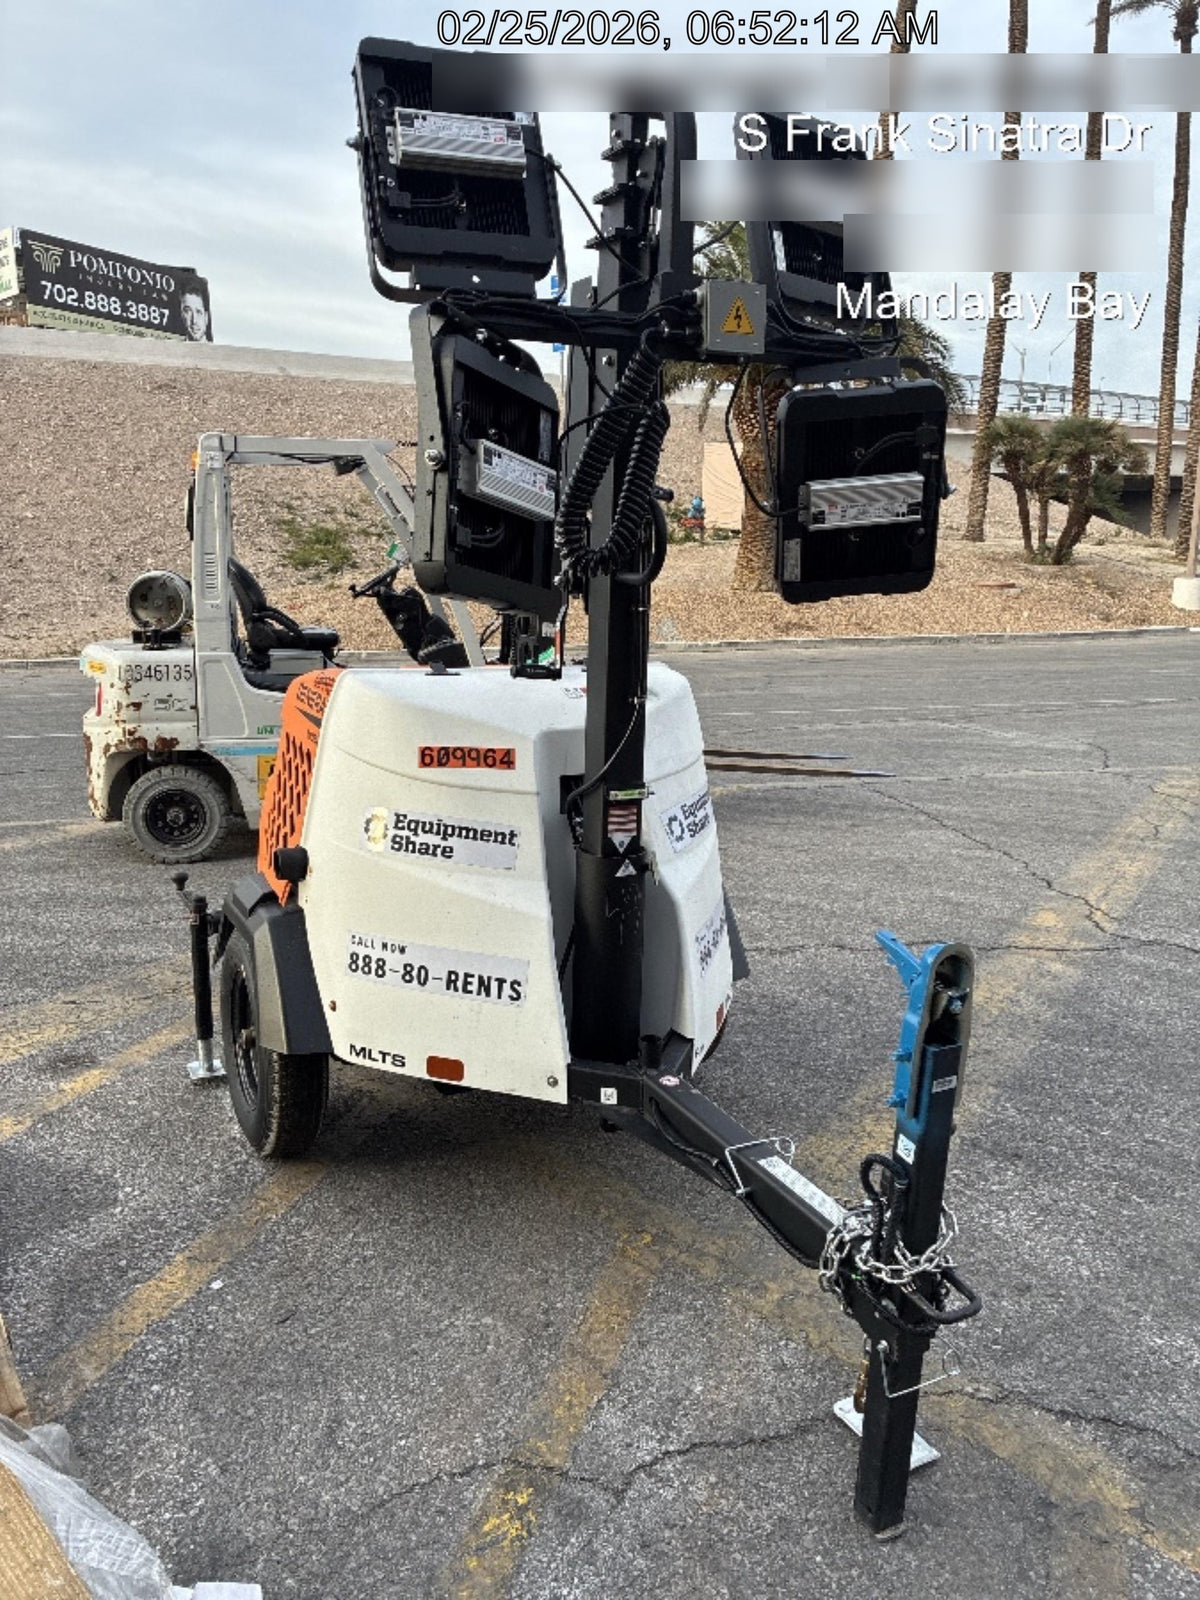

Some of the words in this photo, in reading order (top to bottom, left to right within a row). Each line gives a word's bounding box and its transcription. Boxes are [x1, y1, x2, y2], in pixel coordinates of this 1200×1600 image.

[69, 250, 175, 292] POMPONIO
[40, 281, 170, 326] 702.888.3887
[420, 746, 515, 767] 609964
[393, 812, 518, 848] Equipment
[390, 834, 454, 859] Share
[381, 941, 408, 955] NOW
[348, 951, 522, 1002] 888-80-RENTS
[349, 1043, 406, 1068] MLTS
